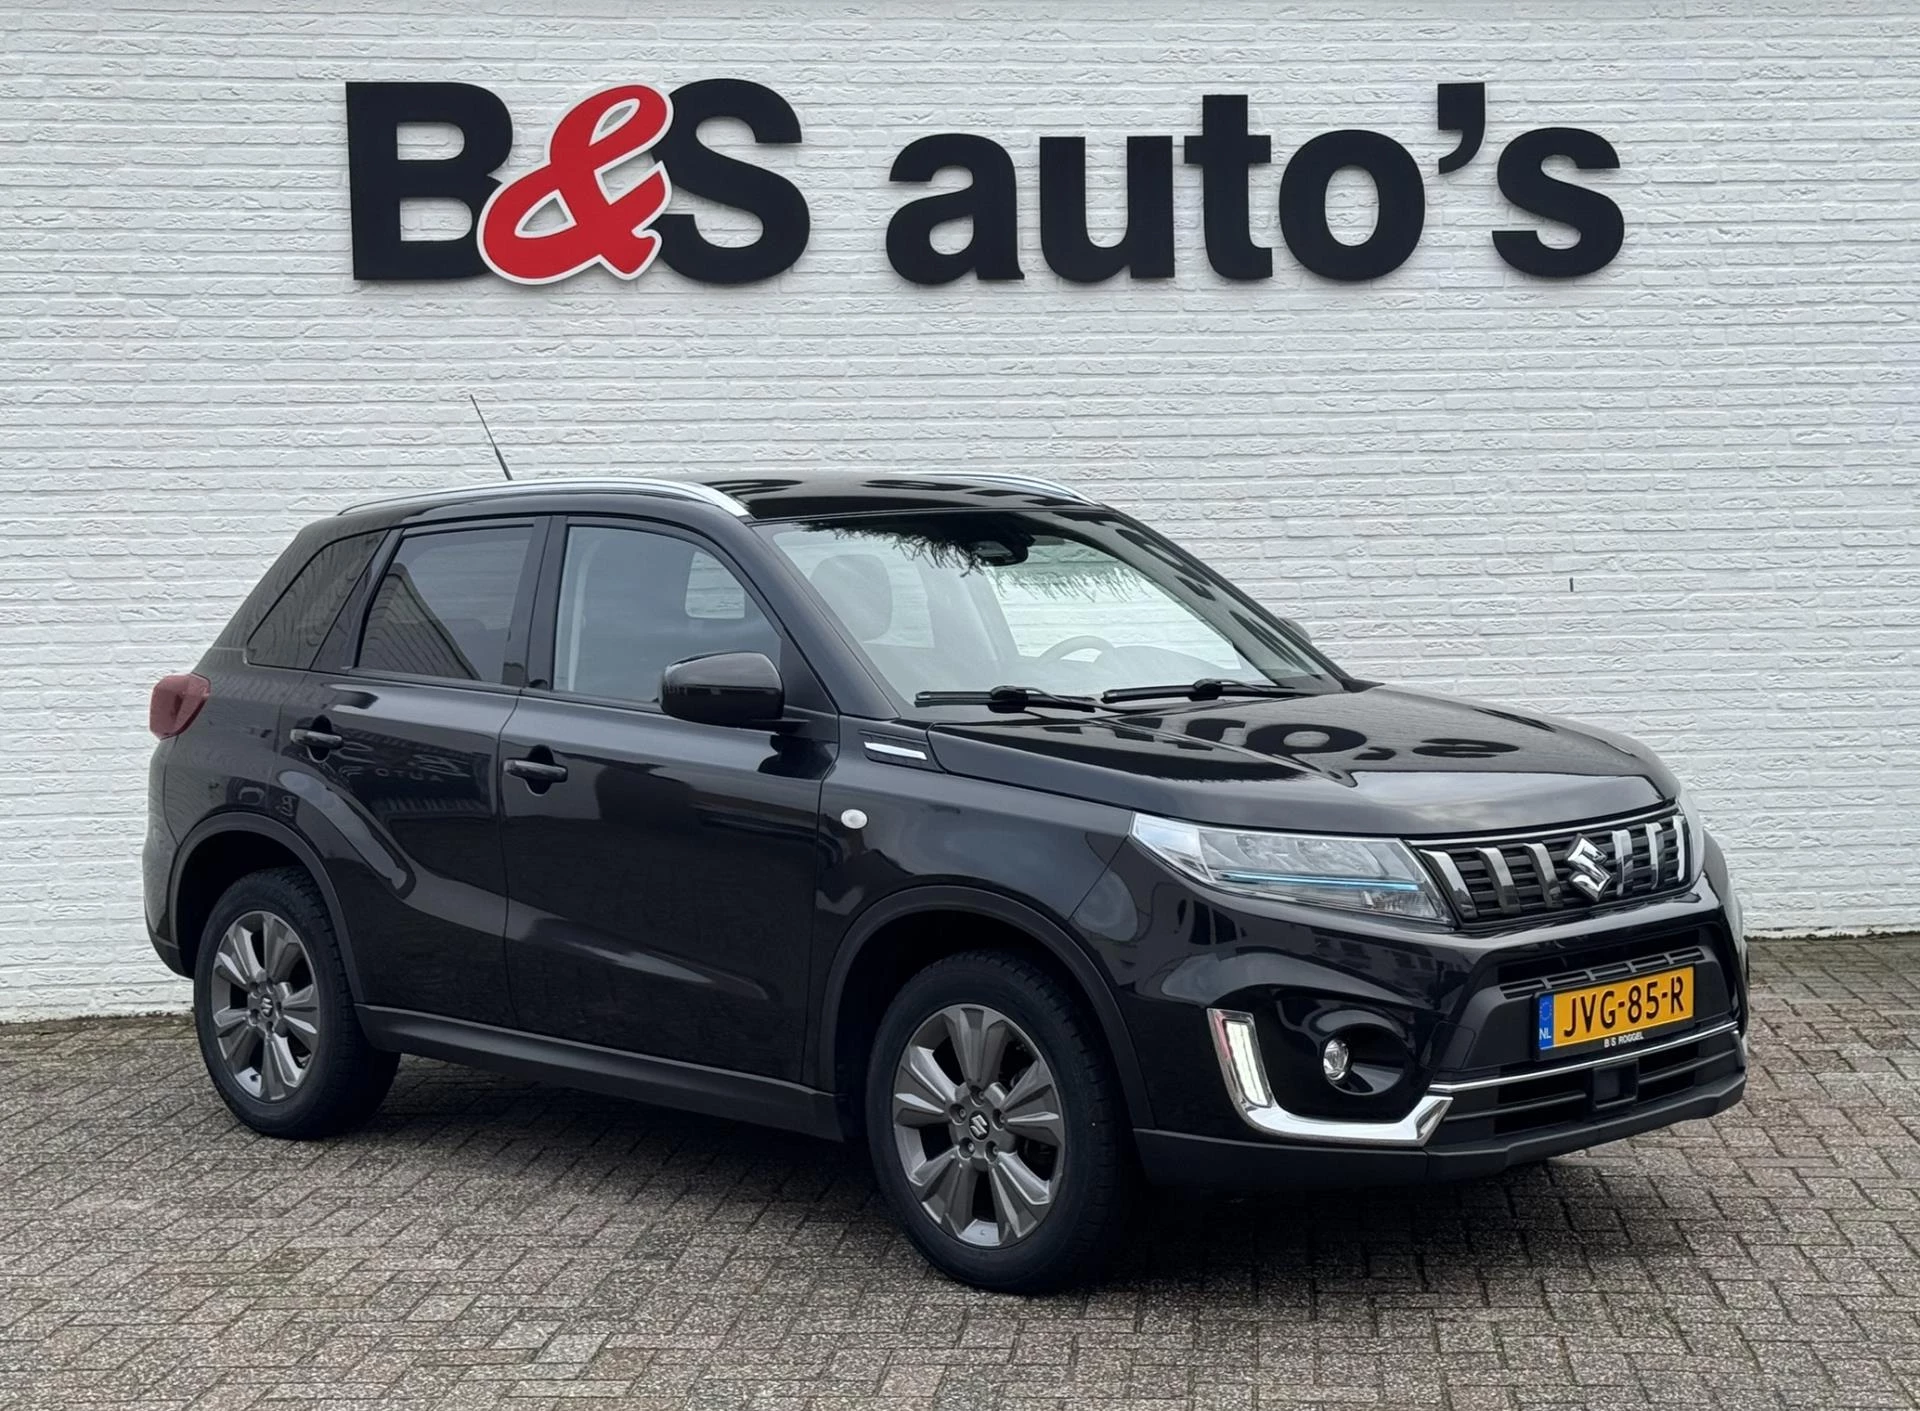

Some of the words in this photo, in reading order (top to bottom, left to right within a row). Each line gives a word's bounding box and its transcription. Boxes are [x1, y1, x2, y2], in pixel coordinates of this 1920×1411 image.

[346, 78, 811, 285] B&S
[886, 82, 1625, 285] auto's
[1563, 976, 1685, 1038] JVG-85-R
[1539, 1026, 1552, 1041] NL
[1618, 1031, 1645, 1045] ROGGEL
